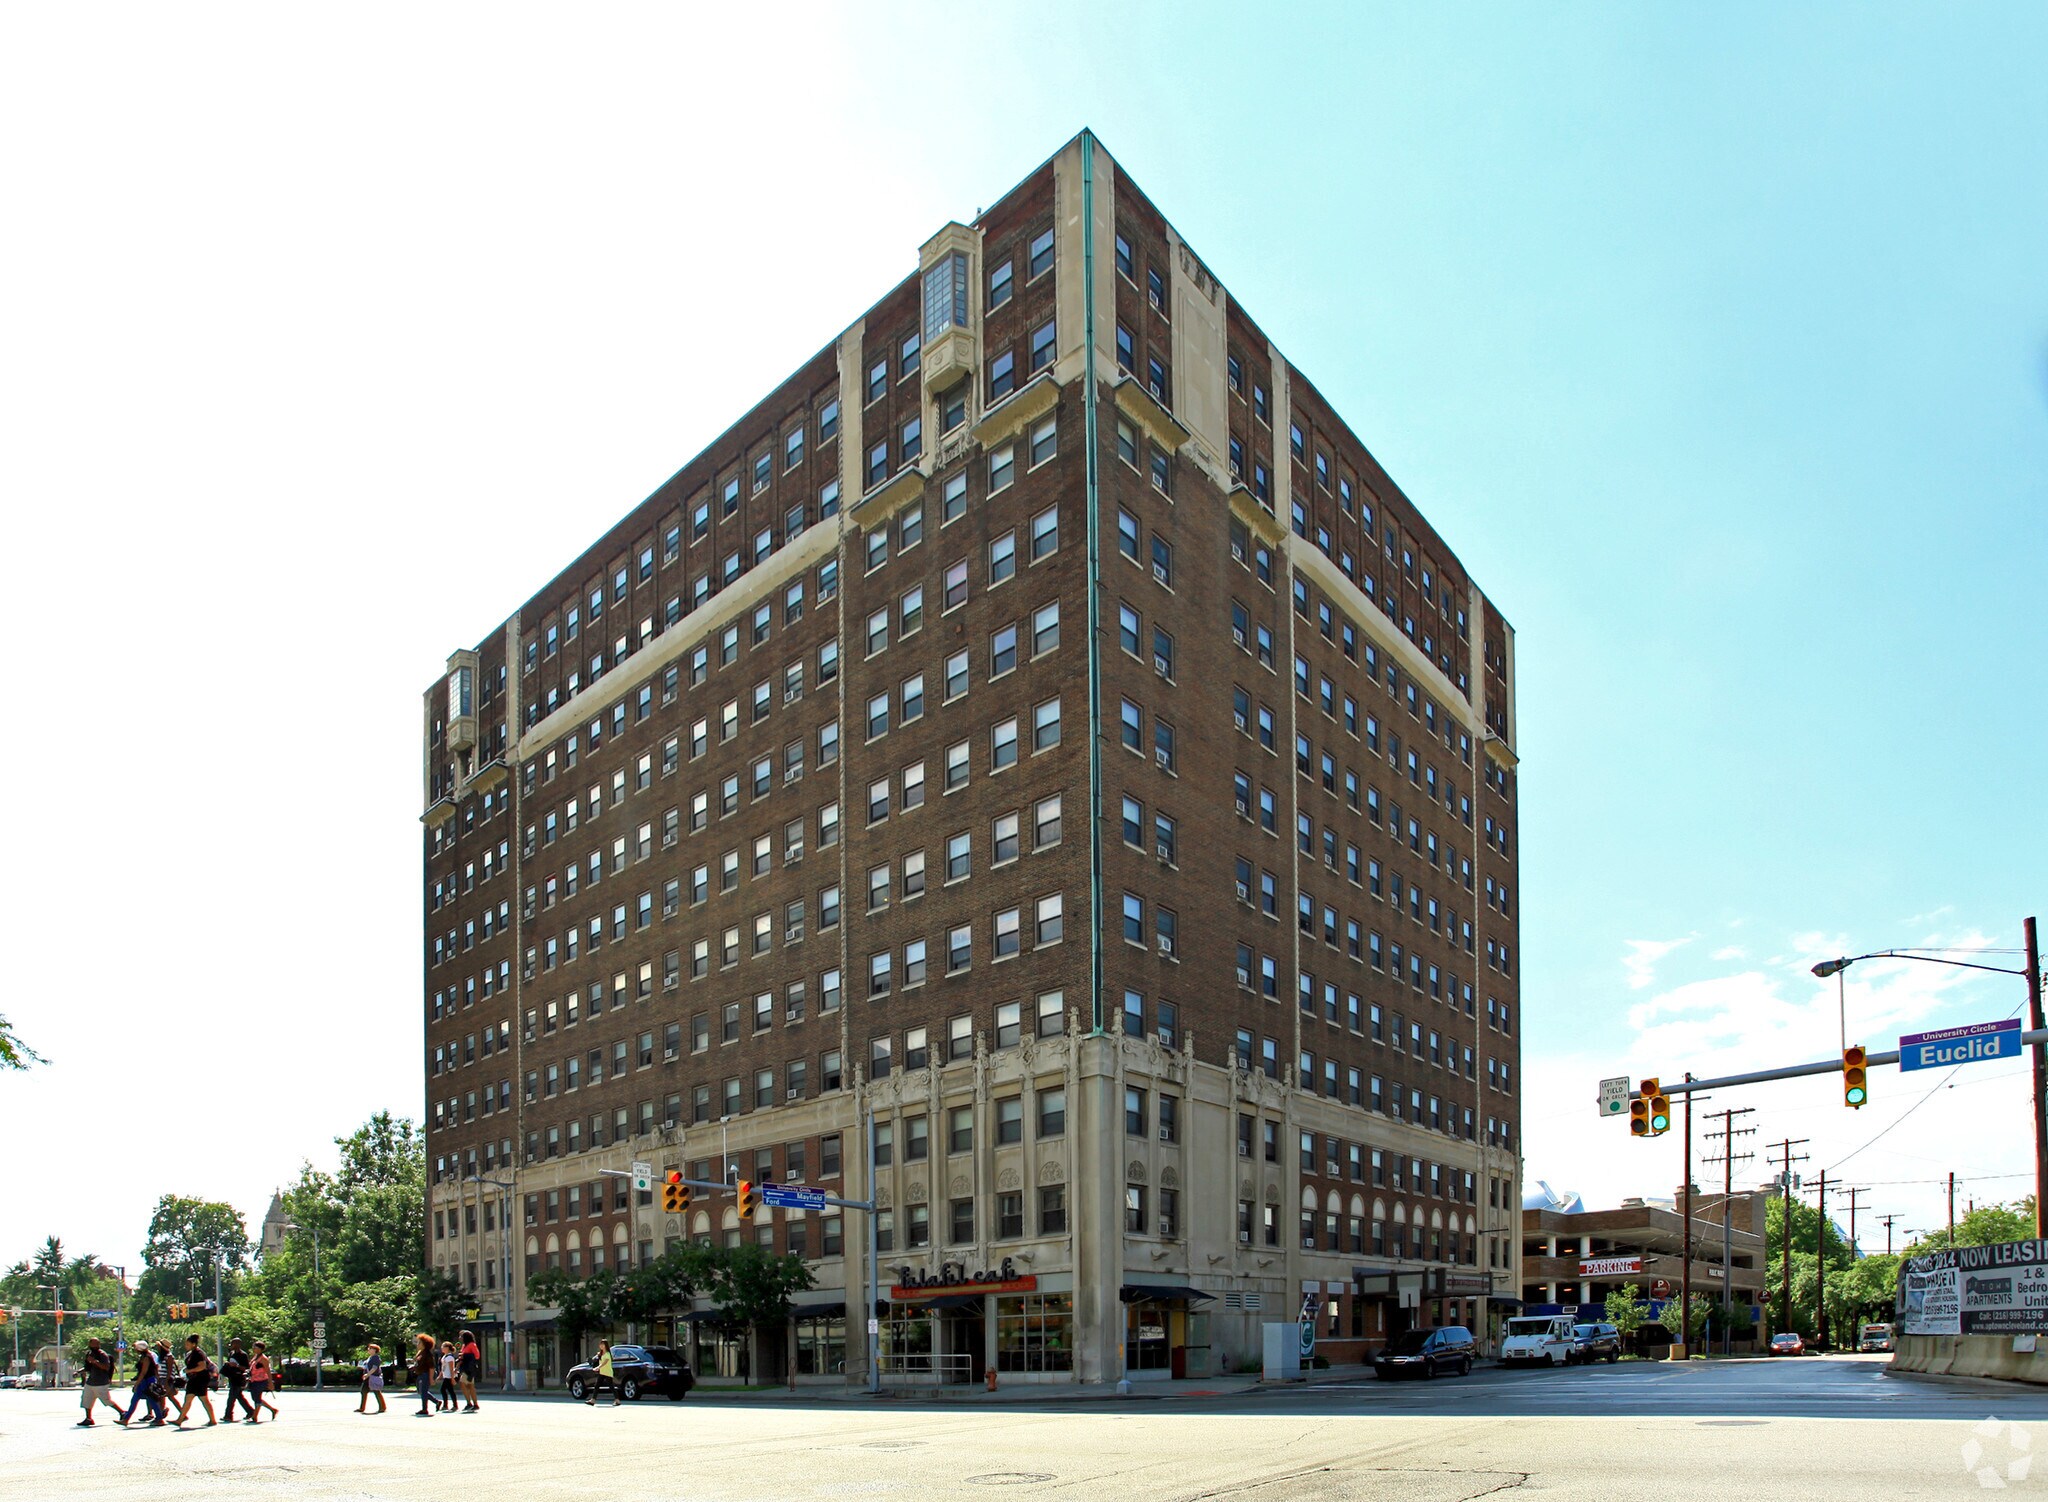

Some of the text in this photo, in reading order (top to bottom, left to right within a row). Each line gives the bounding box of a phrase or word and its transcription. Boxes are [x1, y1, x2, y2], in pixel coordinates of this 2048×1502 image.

[1922, 1024, 1996, 1040] University Circle
[1920, 1036, 2000, 1065] Euclid
[766, 1197, 780, 1205] Ford
[797, 1192, 823, 1201] Mayfield
[1934, 1251, 1956, 1270] 2014
[1960, 1247, 1990, 1268] NOW
[1586, 1261, 1633, 1274] PARKING
[2024, 1267, 2045, 1279] 1 &
[1657, 1279, 1665, 1288] P
[1966, 1293, 2012, 1306] APARTMENTS
[1979, 1310, 2044, 1320] Call: (216) 999-7196
[314, 1329, 325, 1337] 20
